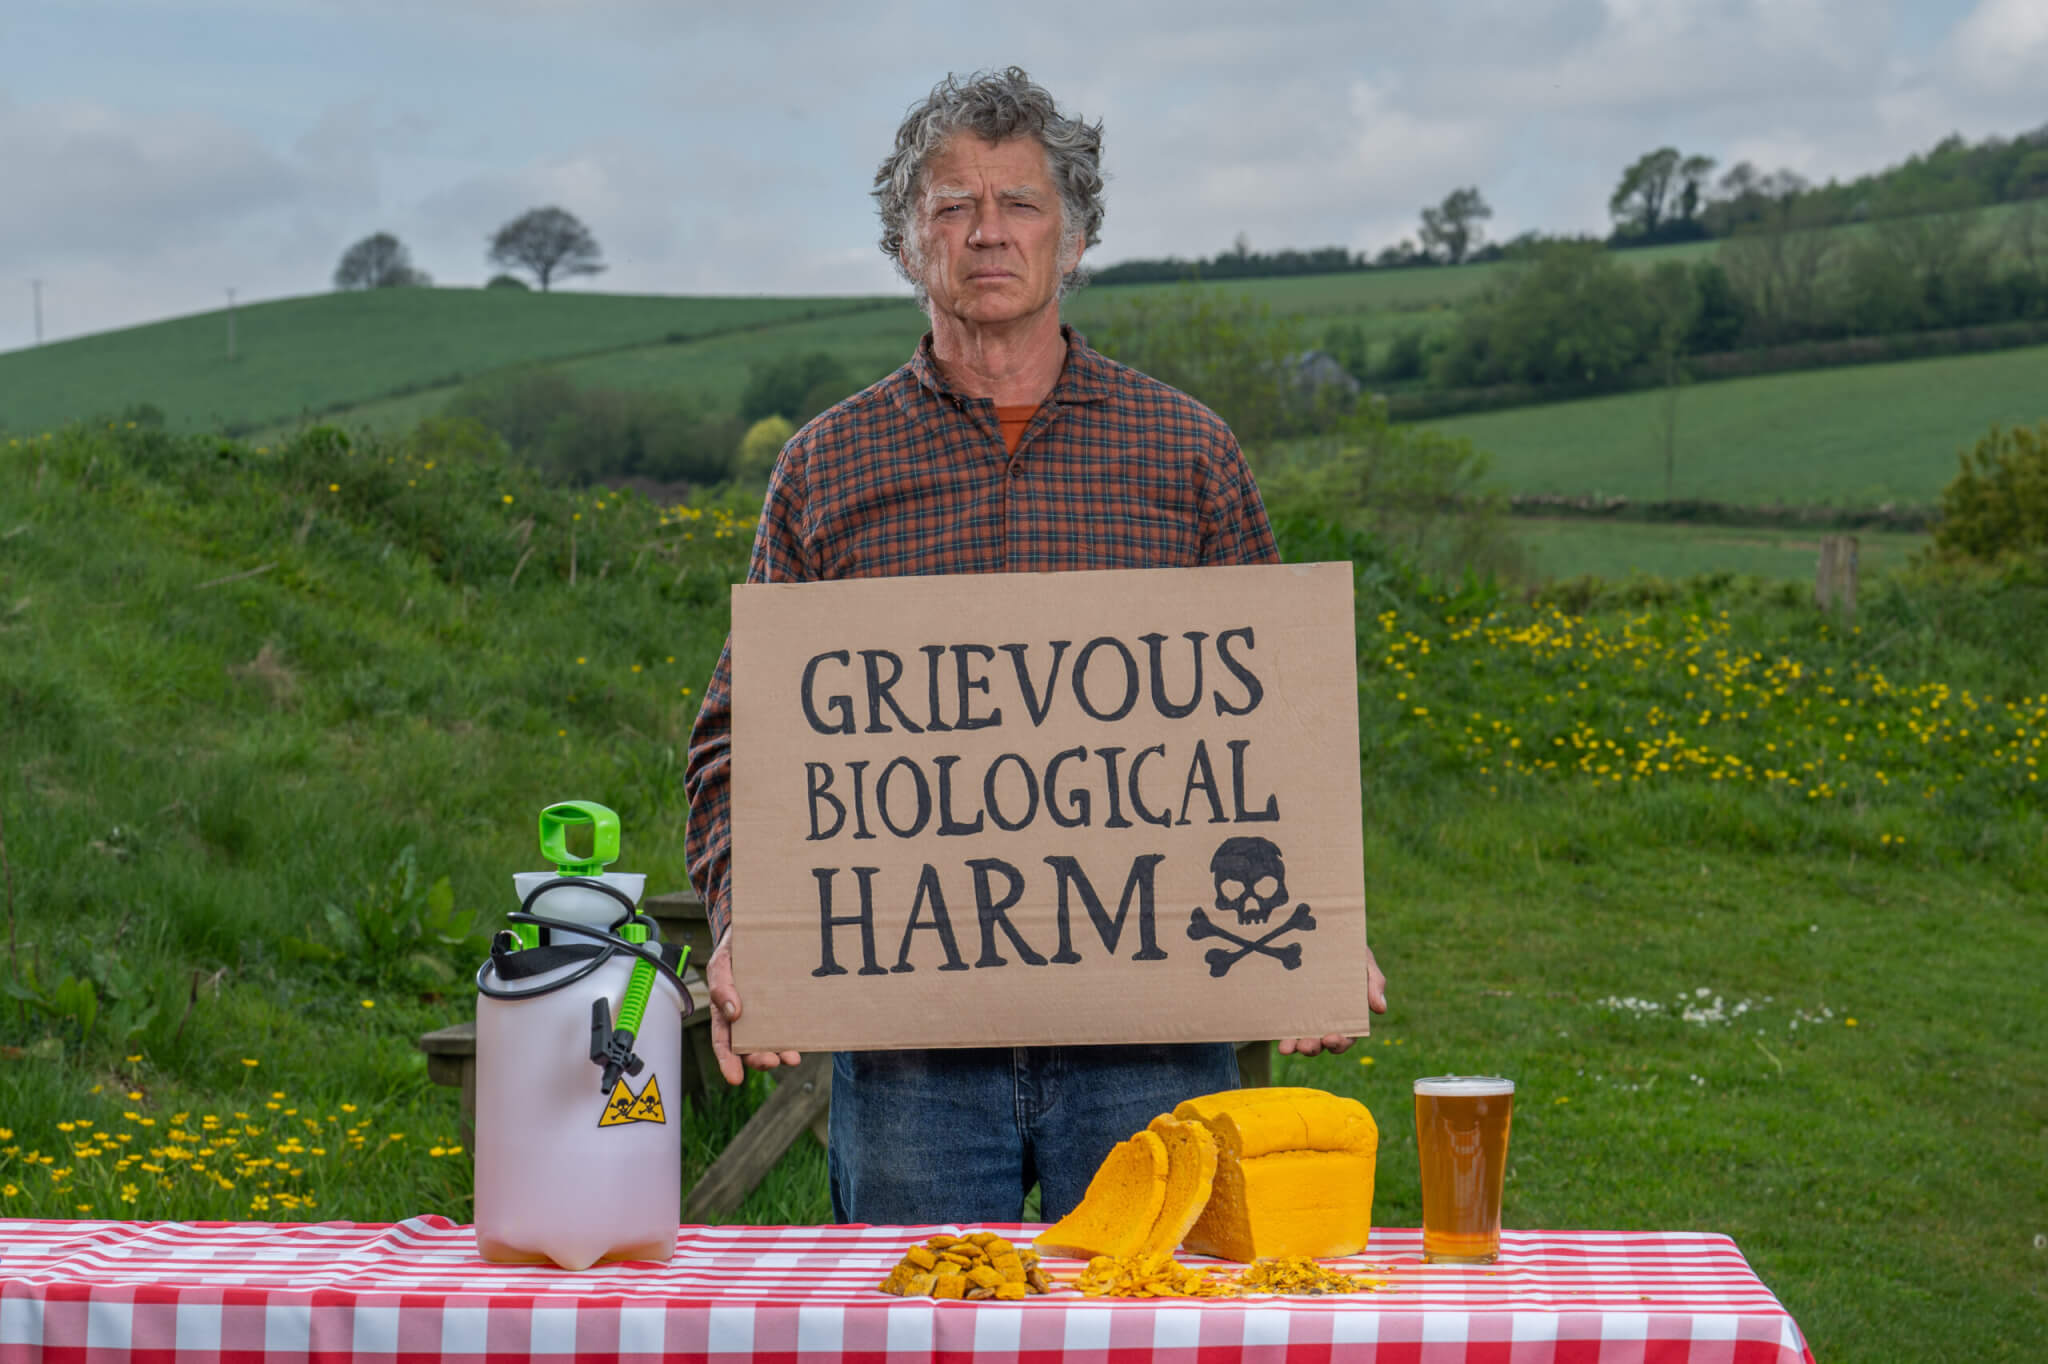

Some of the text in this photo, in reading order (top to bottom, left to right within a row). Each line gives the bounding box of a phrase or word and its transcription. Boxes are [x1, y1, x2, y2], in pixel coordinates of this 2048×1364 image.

[800, 626, 1264, 735] GRIEVOUS
[804, 739, 1281, 841] BIOLOGICAL
[811, 853, 1169, 978] HARM
